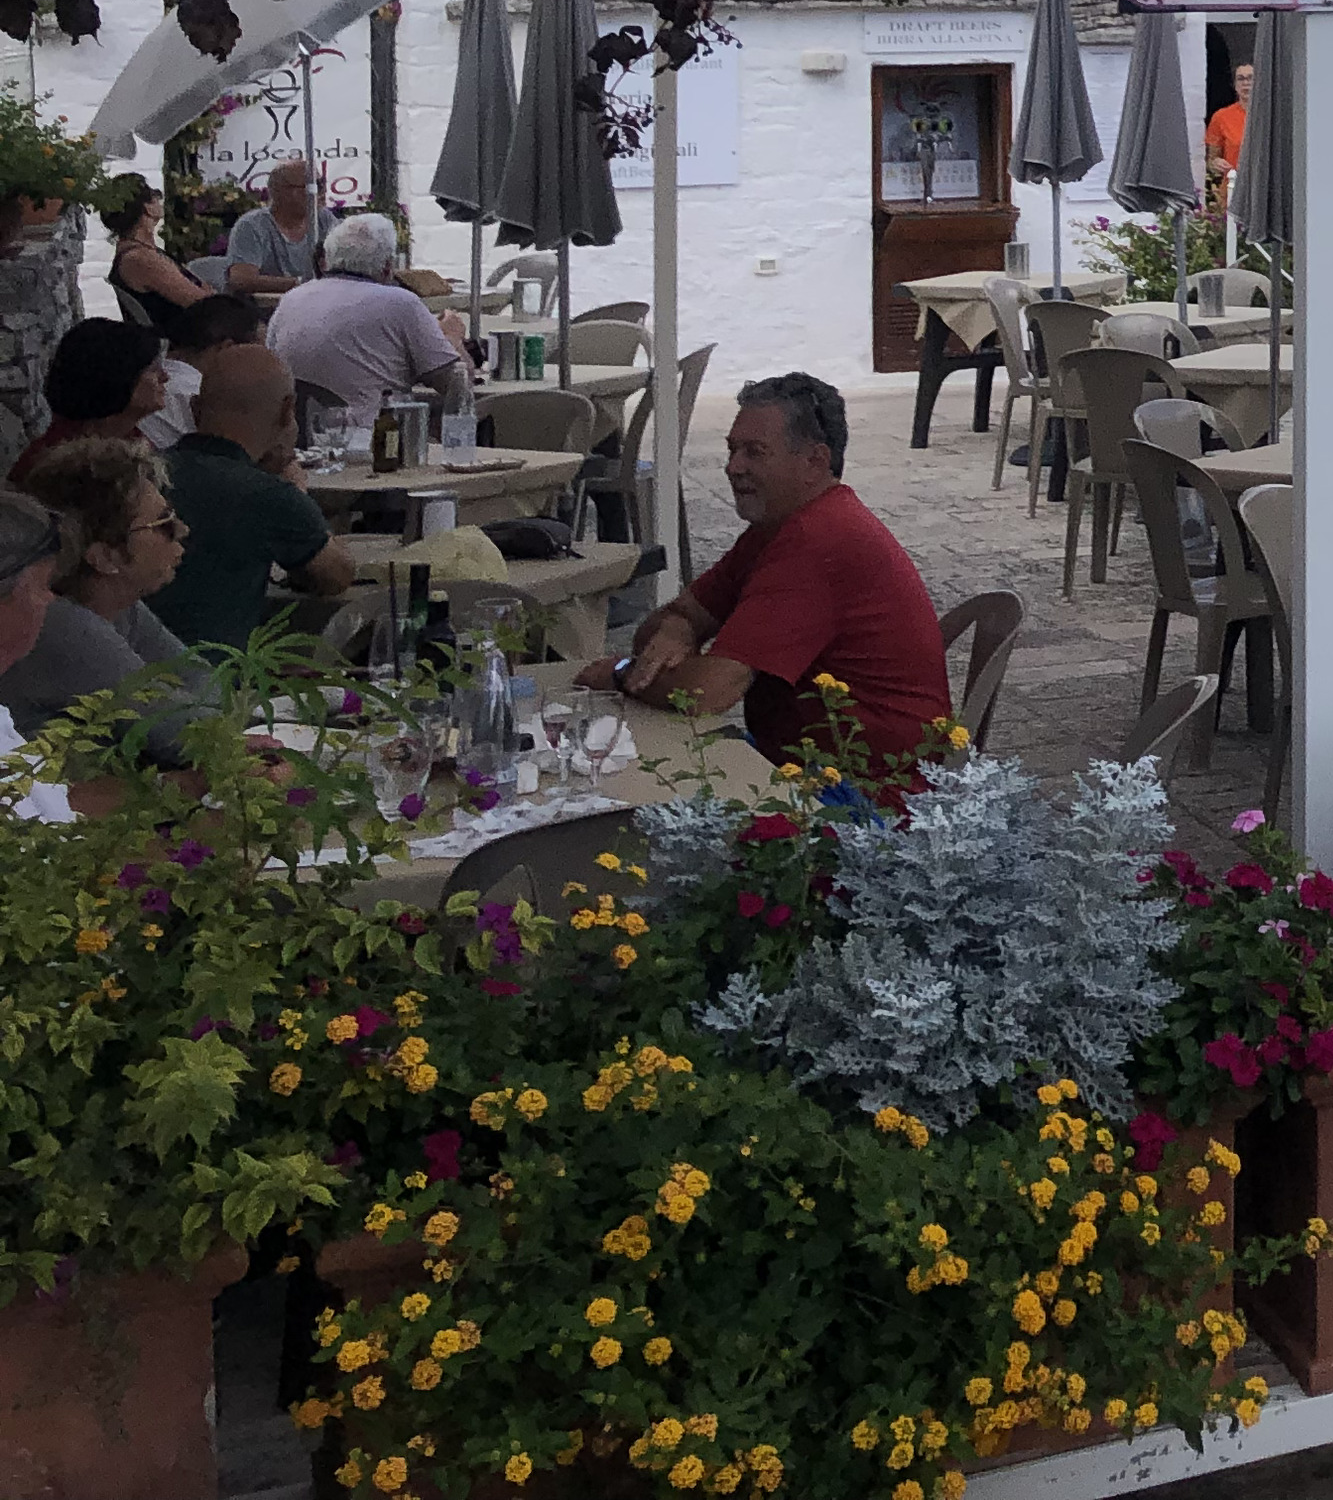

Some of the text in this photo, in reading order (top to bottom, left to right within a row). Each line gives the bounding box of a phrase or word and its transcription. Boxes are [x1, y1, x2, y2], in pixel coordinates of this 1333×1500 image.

[889, 20, 1002, 32] DRAFT BEERS
[877, 34, 926, 45] BIRRA
[210, 141, 234, 162] la
